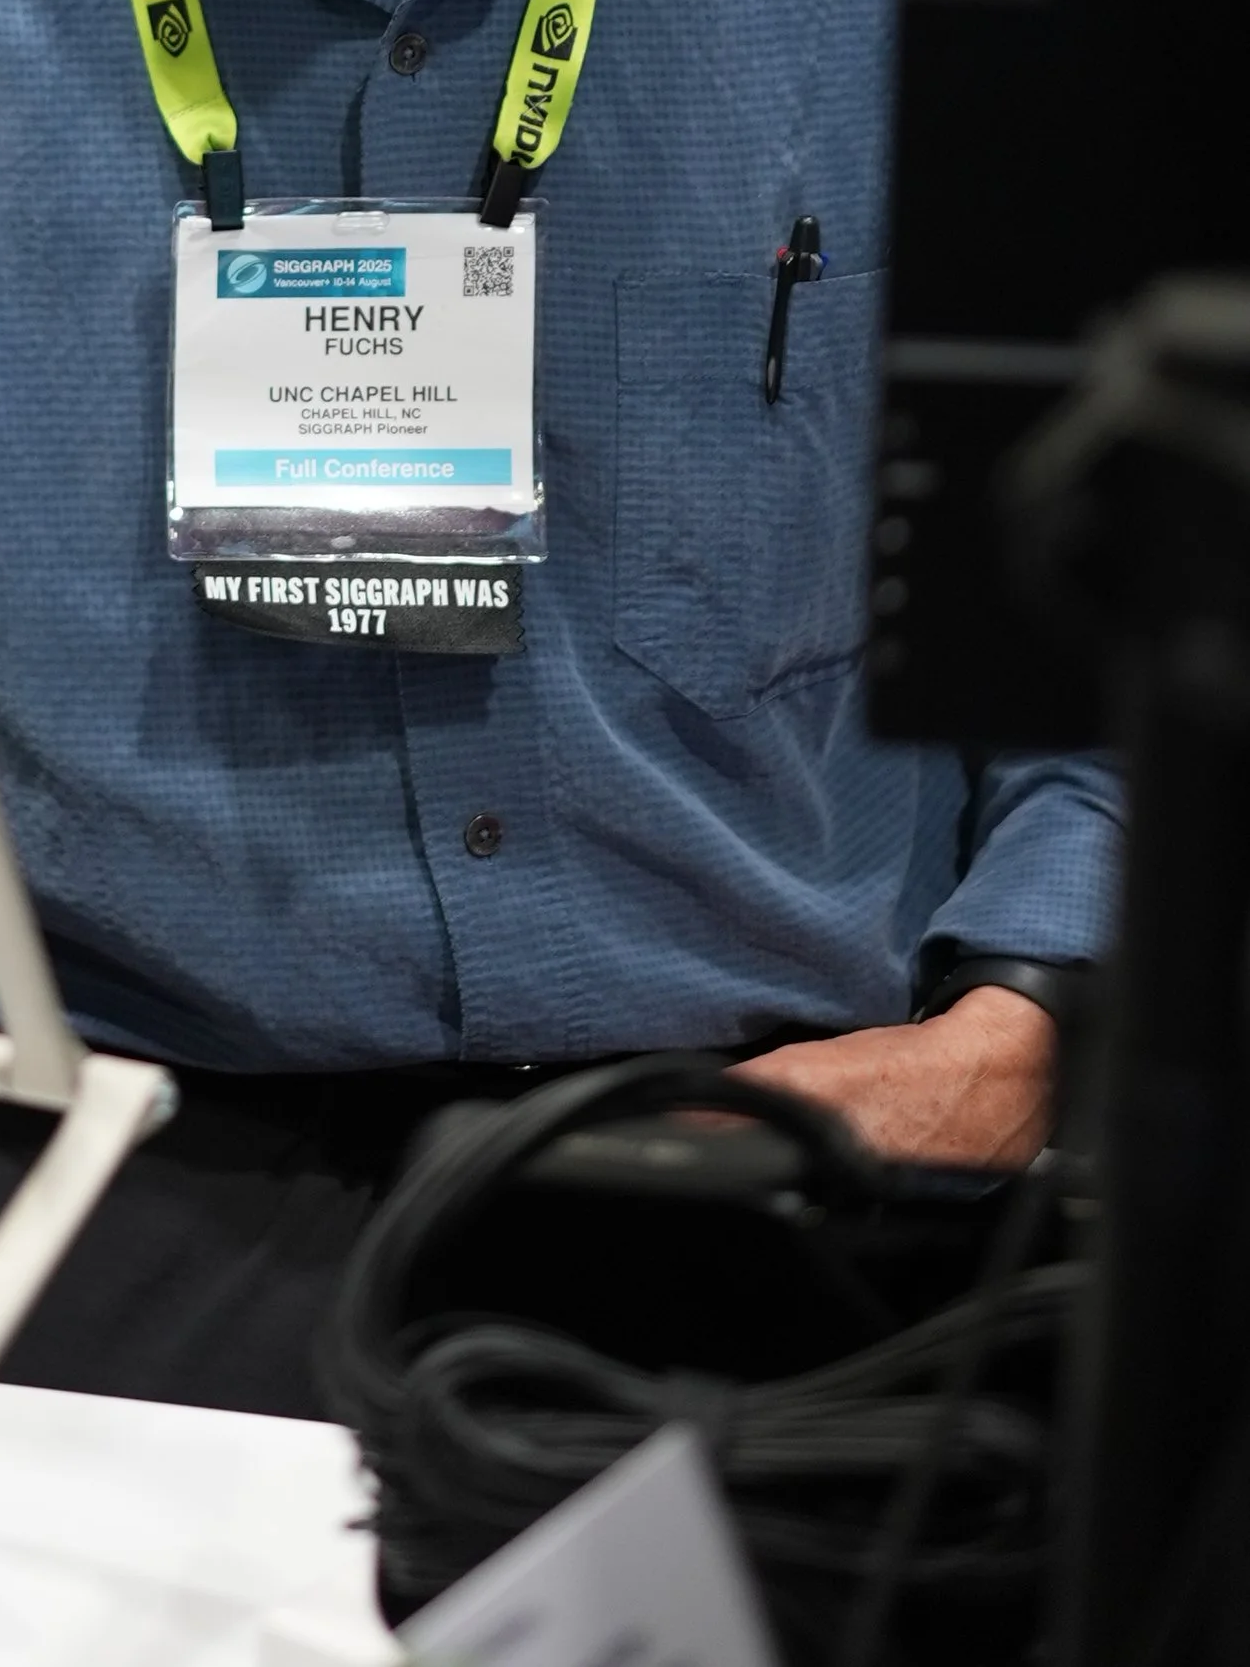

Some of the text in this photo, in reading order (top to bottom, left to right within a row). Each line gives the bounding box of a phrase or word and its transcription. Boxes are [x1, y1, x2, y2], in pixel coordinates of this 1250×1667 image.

[273, 259, 392, 274] SIGGRAPH 2025
[358, 277, 391, 289] August
[305, 305, 424, 332] HENRY
[324, 337, 403, 355] FUCHS
[269, 385, 458, 403] UNC CHAPEL HILL
[301, 407, 421, 420] CHAPEL HILL, NC
[298, 423, 428, 435] SIGGRAPH Pioneer
[275, 457, 455, 479] Full Conference
[204, 576, 510, 608] MY FIRST SIGGRAPH WAS
[327, 608, 387, 635] 1977
